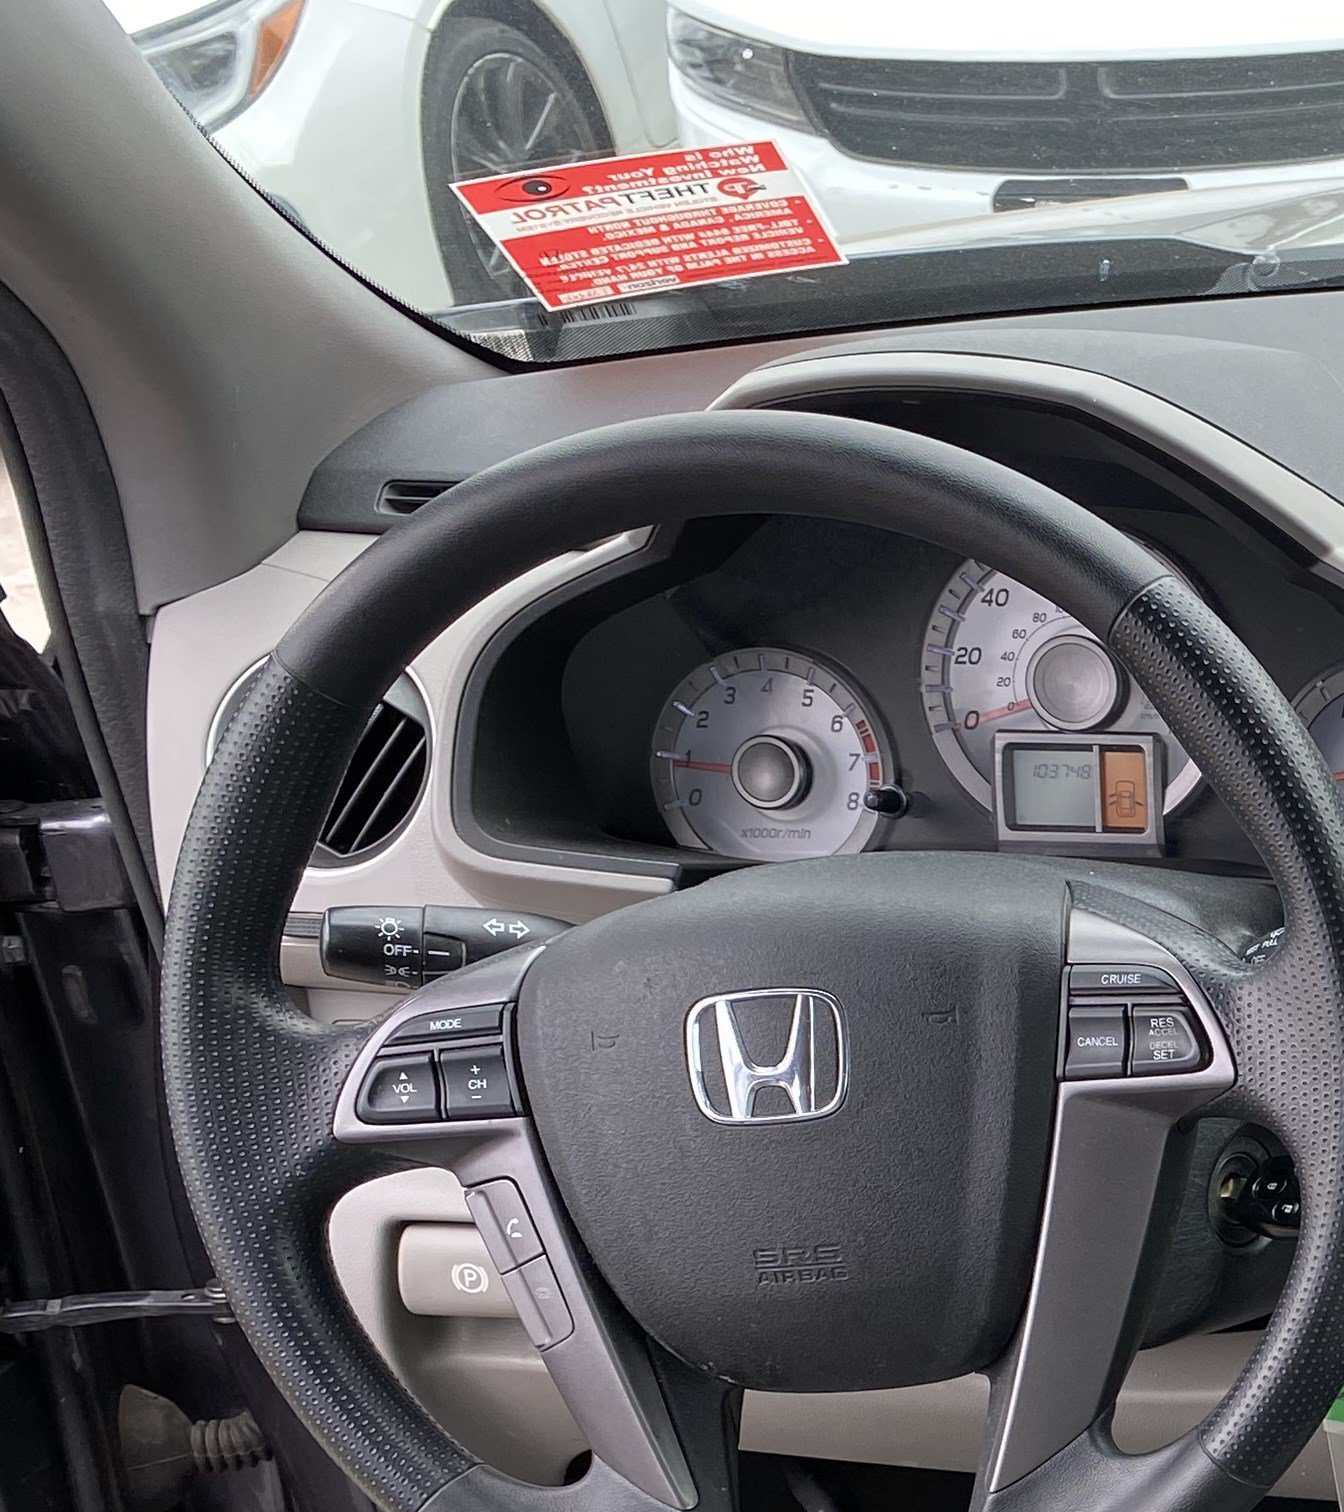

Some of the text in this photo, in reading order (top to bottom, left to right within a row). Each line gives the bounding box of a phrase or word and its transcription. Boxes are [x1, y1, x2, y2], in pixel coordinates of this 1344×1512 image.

[981, 588, 1009, 607] 40
[1032, 612, 1047, 622] 80
[1012, 629, 1026, 639] 60
[954, 647, 982, 665] 20
[1000, 652, 1015, 661] 40
[761, 678, 773, 694] 4
[996, 677, 1011, 687] 20
[724, 687, 737, 704] 3
[802, 690, 814, 707] 5
[1007, 701, 1015, 711] 0
[696, 711, 709, 728] 2
[831, 715, 843, 733] 6
[964, 711, 979, 729] 0
[849, 753, 861, 771] 7
[1033, 764, 1091, 779] 103748
[689, 788, 702, 805] 0
[847, 792, 860, 810] 8
[1101, 974, 1141, 984] CRUISE
[430, 1018, 462, 1030] MODE
[1150, 1017, 1175, 1028] RES
[1148, 1028, 1178, 1036] ACCEL
[1077, 1037, 1118, 1047] CANCEL
[1149, 1041, 1178, 1050] DECEL
[1153, 1049, 1176, 1060] SET
[392, 1083, 418, 1094] VOL
[468, 1079, 487, 1090] CH
[753, 1243, 843, 1267] SRS
